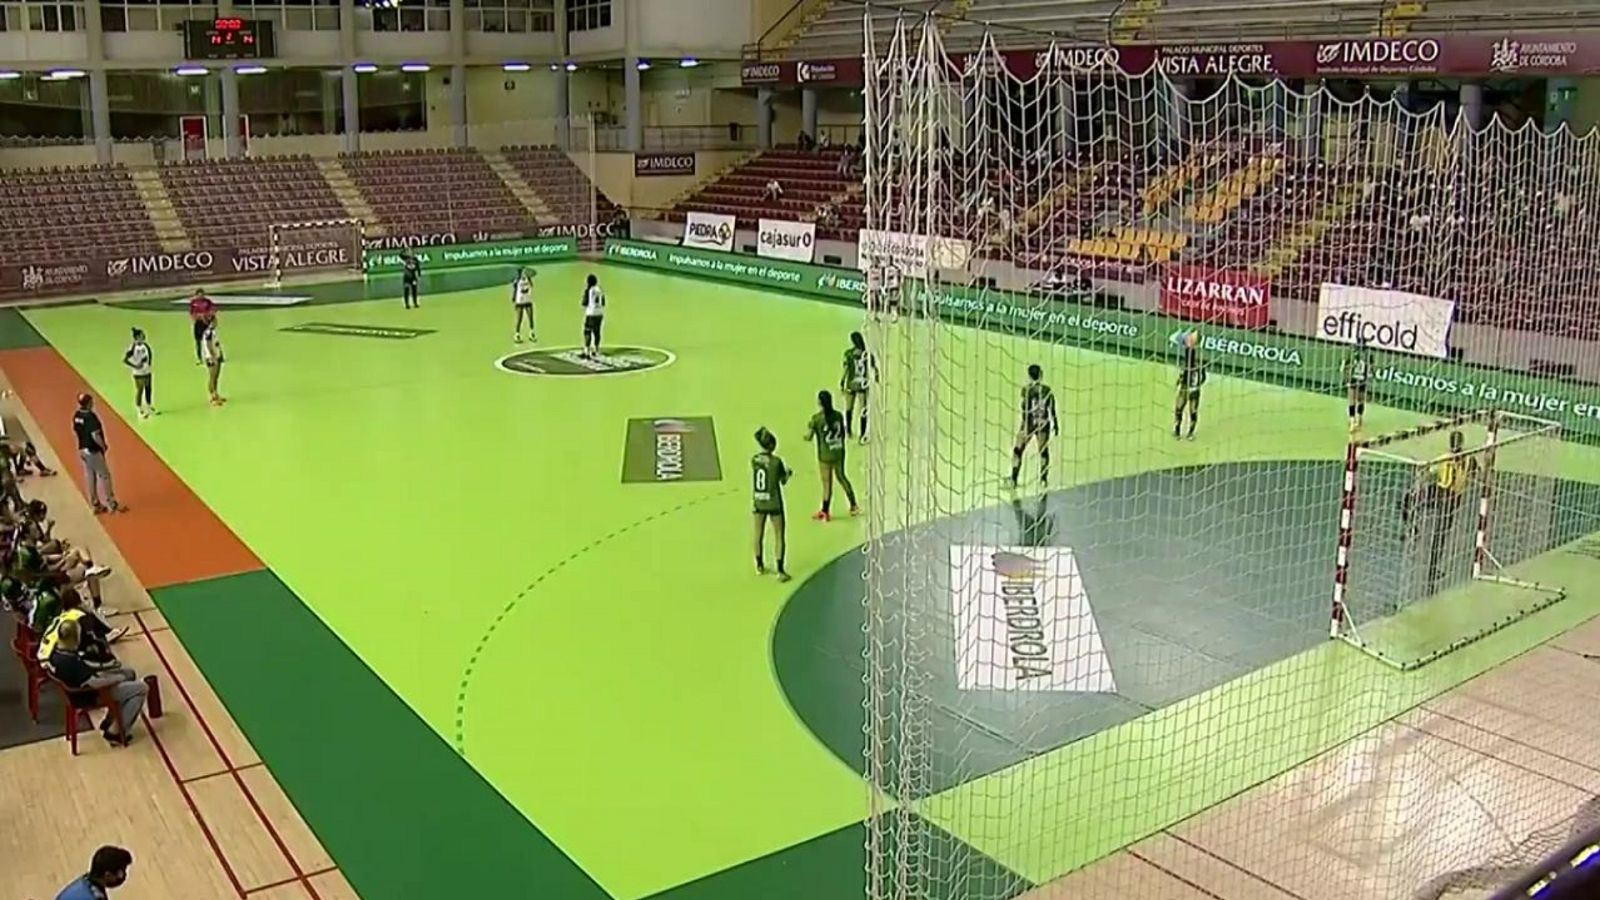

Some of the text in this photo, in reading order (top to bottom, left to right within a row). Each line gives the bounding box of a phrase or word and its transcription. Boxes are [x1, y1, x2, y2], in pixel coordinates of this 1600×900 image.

[1054, 46, 1119, 66] IMDECO
[1159, 54, 1273, 74] VISTA ALEGRE
[1343, 40, 1438, 62] IMDECO
[132, 251, 213, 273] IMDECO
[285, 248, 349, 268] ALEGRE
[1168, 276, 1264, 305] LIZARRAN
[996, 302, 1008, 314] la
[1009, 305, 1048, 321] mujer
[1049, 312, 1066, 324] en
[1068, 314, 1080, 327] el
[1082, 316, 1138, 337] deporte
[1323, 311, 1417, 351] efficold
[1200, 335, 1301, 366] IBERDROLA
[1461, 383, 1475, 396] a
[1479, 382, 1497, 400] la
[1502, 390, 1570, 412] mujer
[756, 468, 766, 491] 8
[1001, 580, 1053, 681] IBERDROLA
